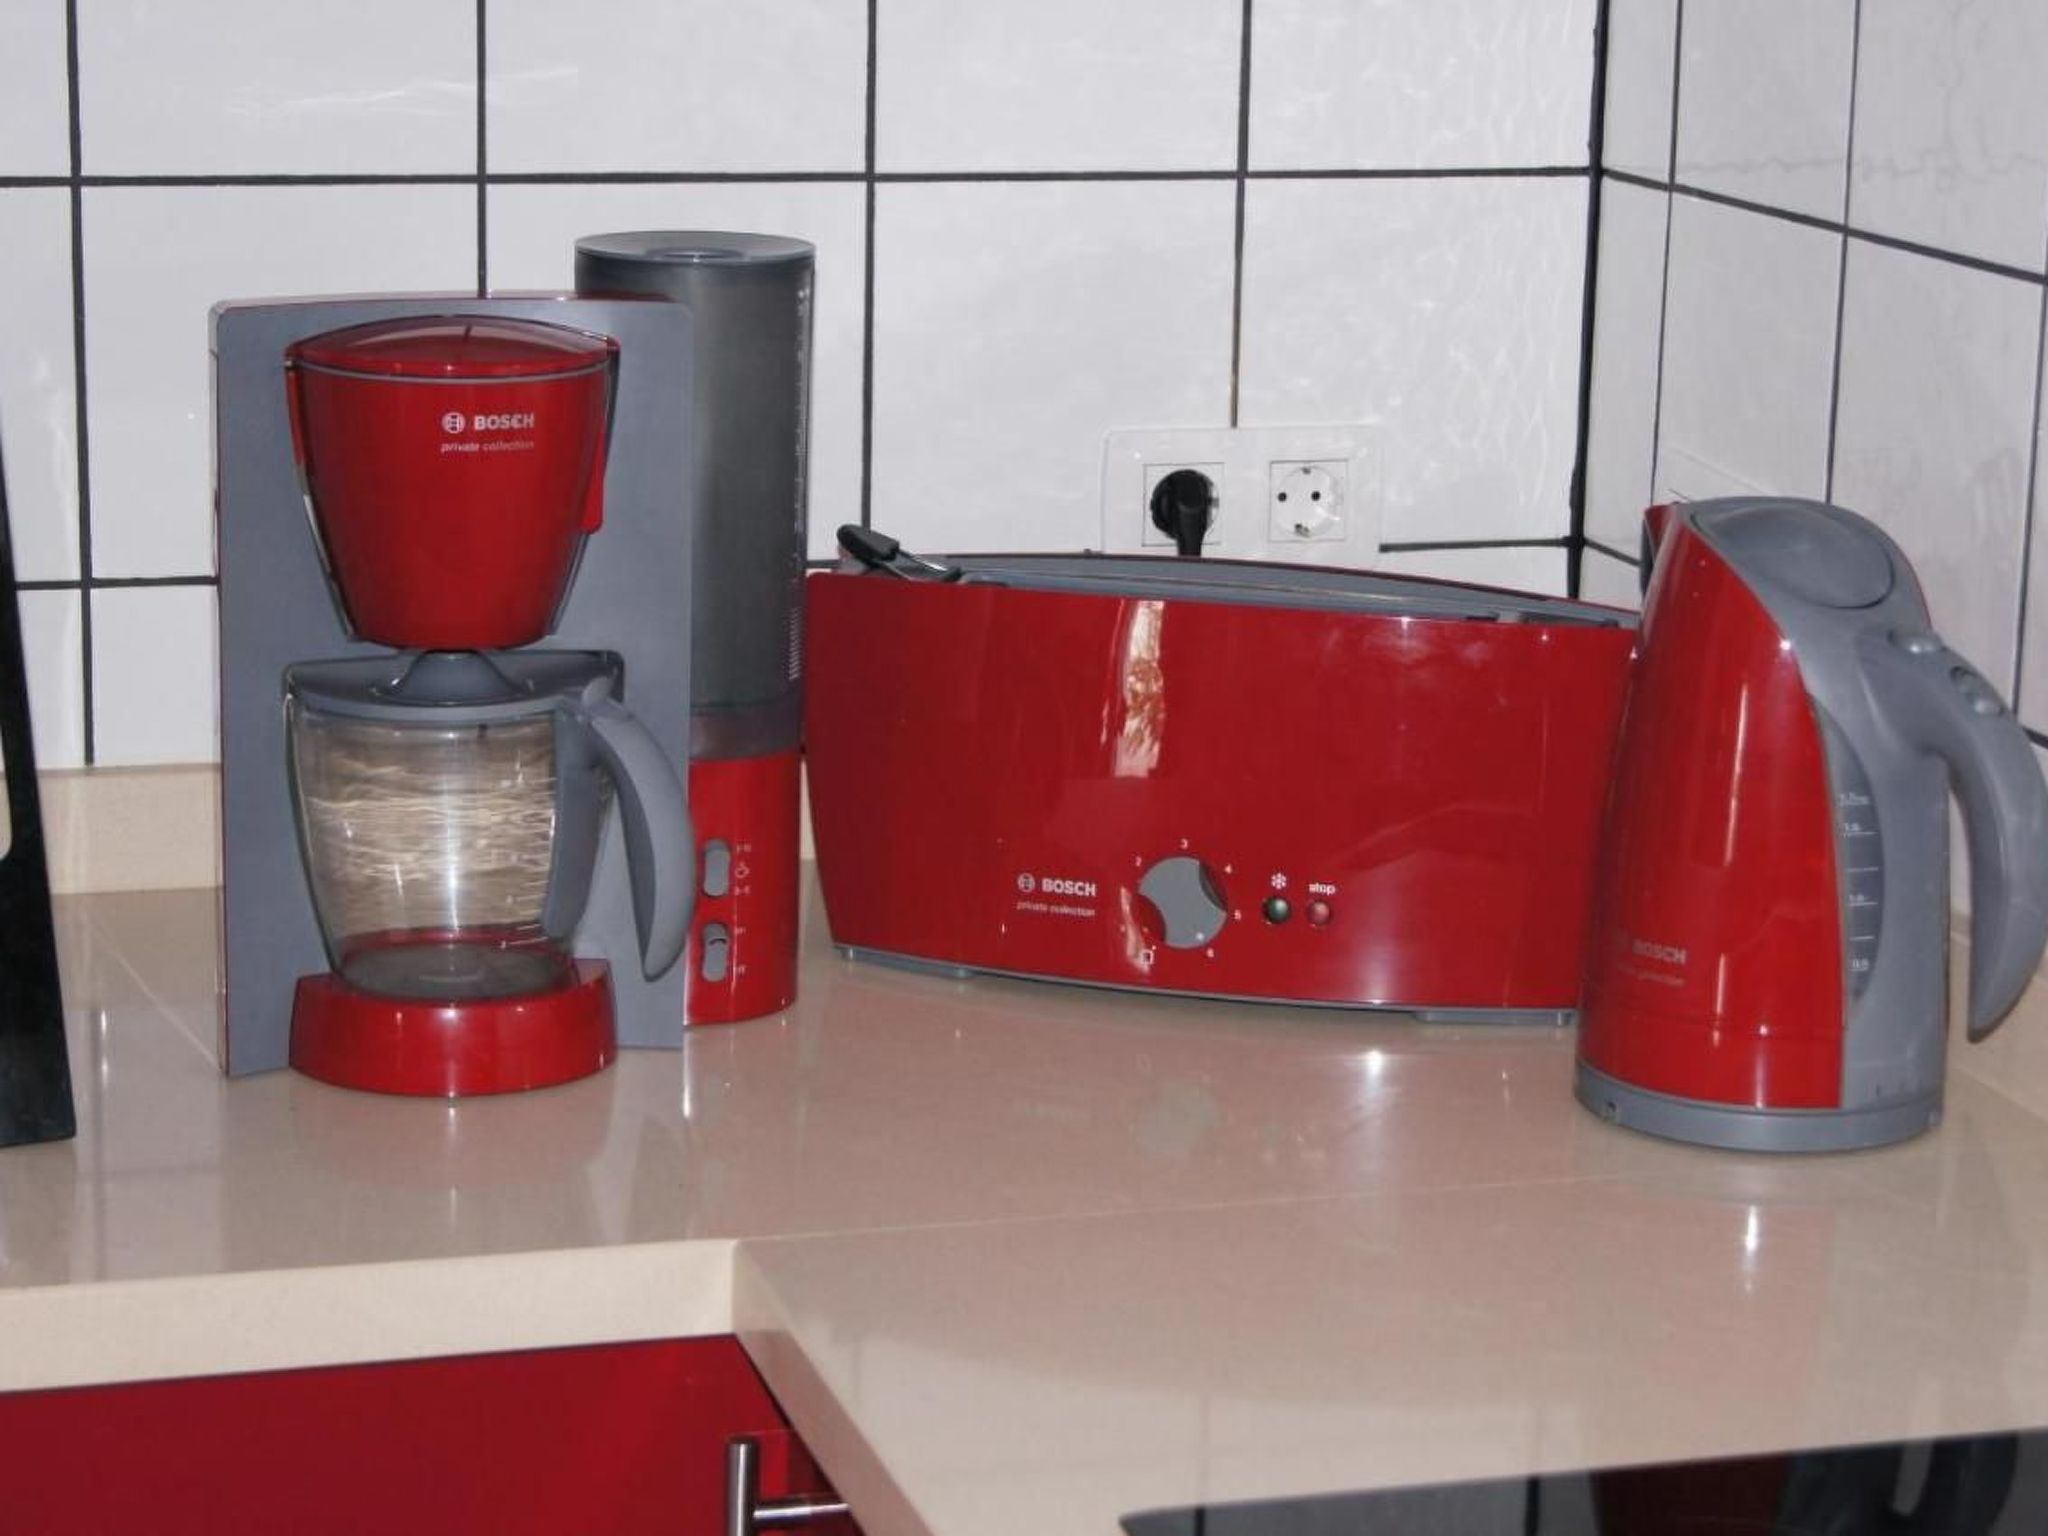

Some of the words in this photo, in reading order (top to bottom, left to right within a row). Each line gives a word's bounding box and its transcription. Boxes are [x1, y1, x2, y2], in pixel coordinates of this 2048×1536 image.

[474, 413, 535, 431] BOSCH
[1042, 878, 1097, 897] BOSCH
[1309, 883, 1337, 896] stop
